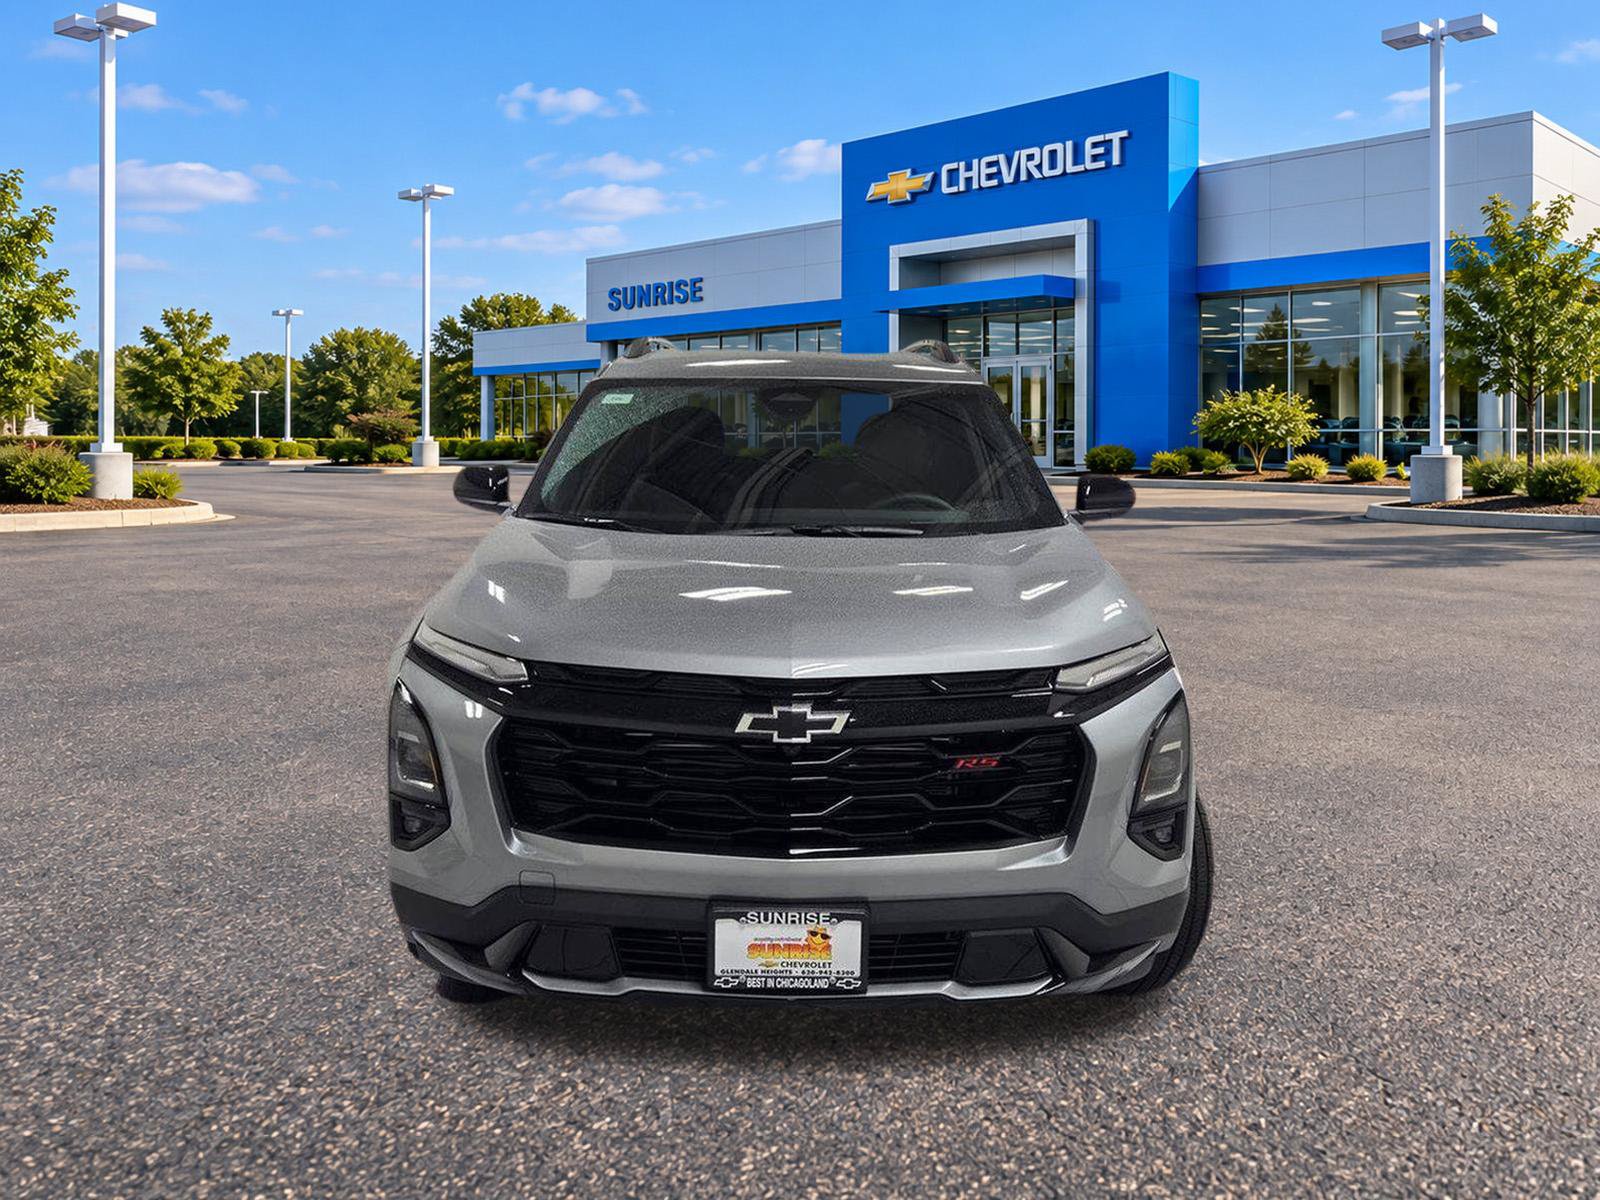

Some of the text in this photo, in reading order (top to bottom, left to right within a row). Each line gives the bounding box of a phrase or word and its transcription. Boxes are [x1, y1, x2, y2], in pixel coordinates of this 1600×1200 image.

[941, 129, 1129, 194] CHEVROLET
[608, 277, 704, 312] SUNRISE
[955, 757, 1000, 768] RS
[747, 912, 831, 925] SUNRISE
[780, 961, 832, 969] CHEVROLET
[746, 977, 829, 989] BEST IN CHICAGOLAND
